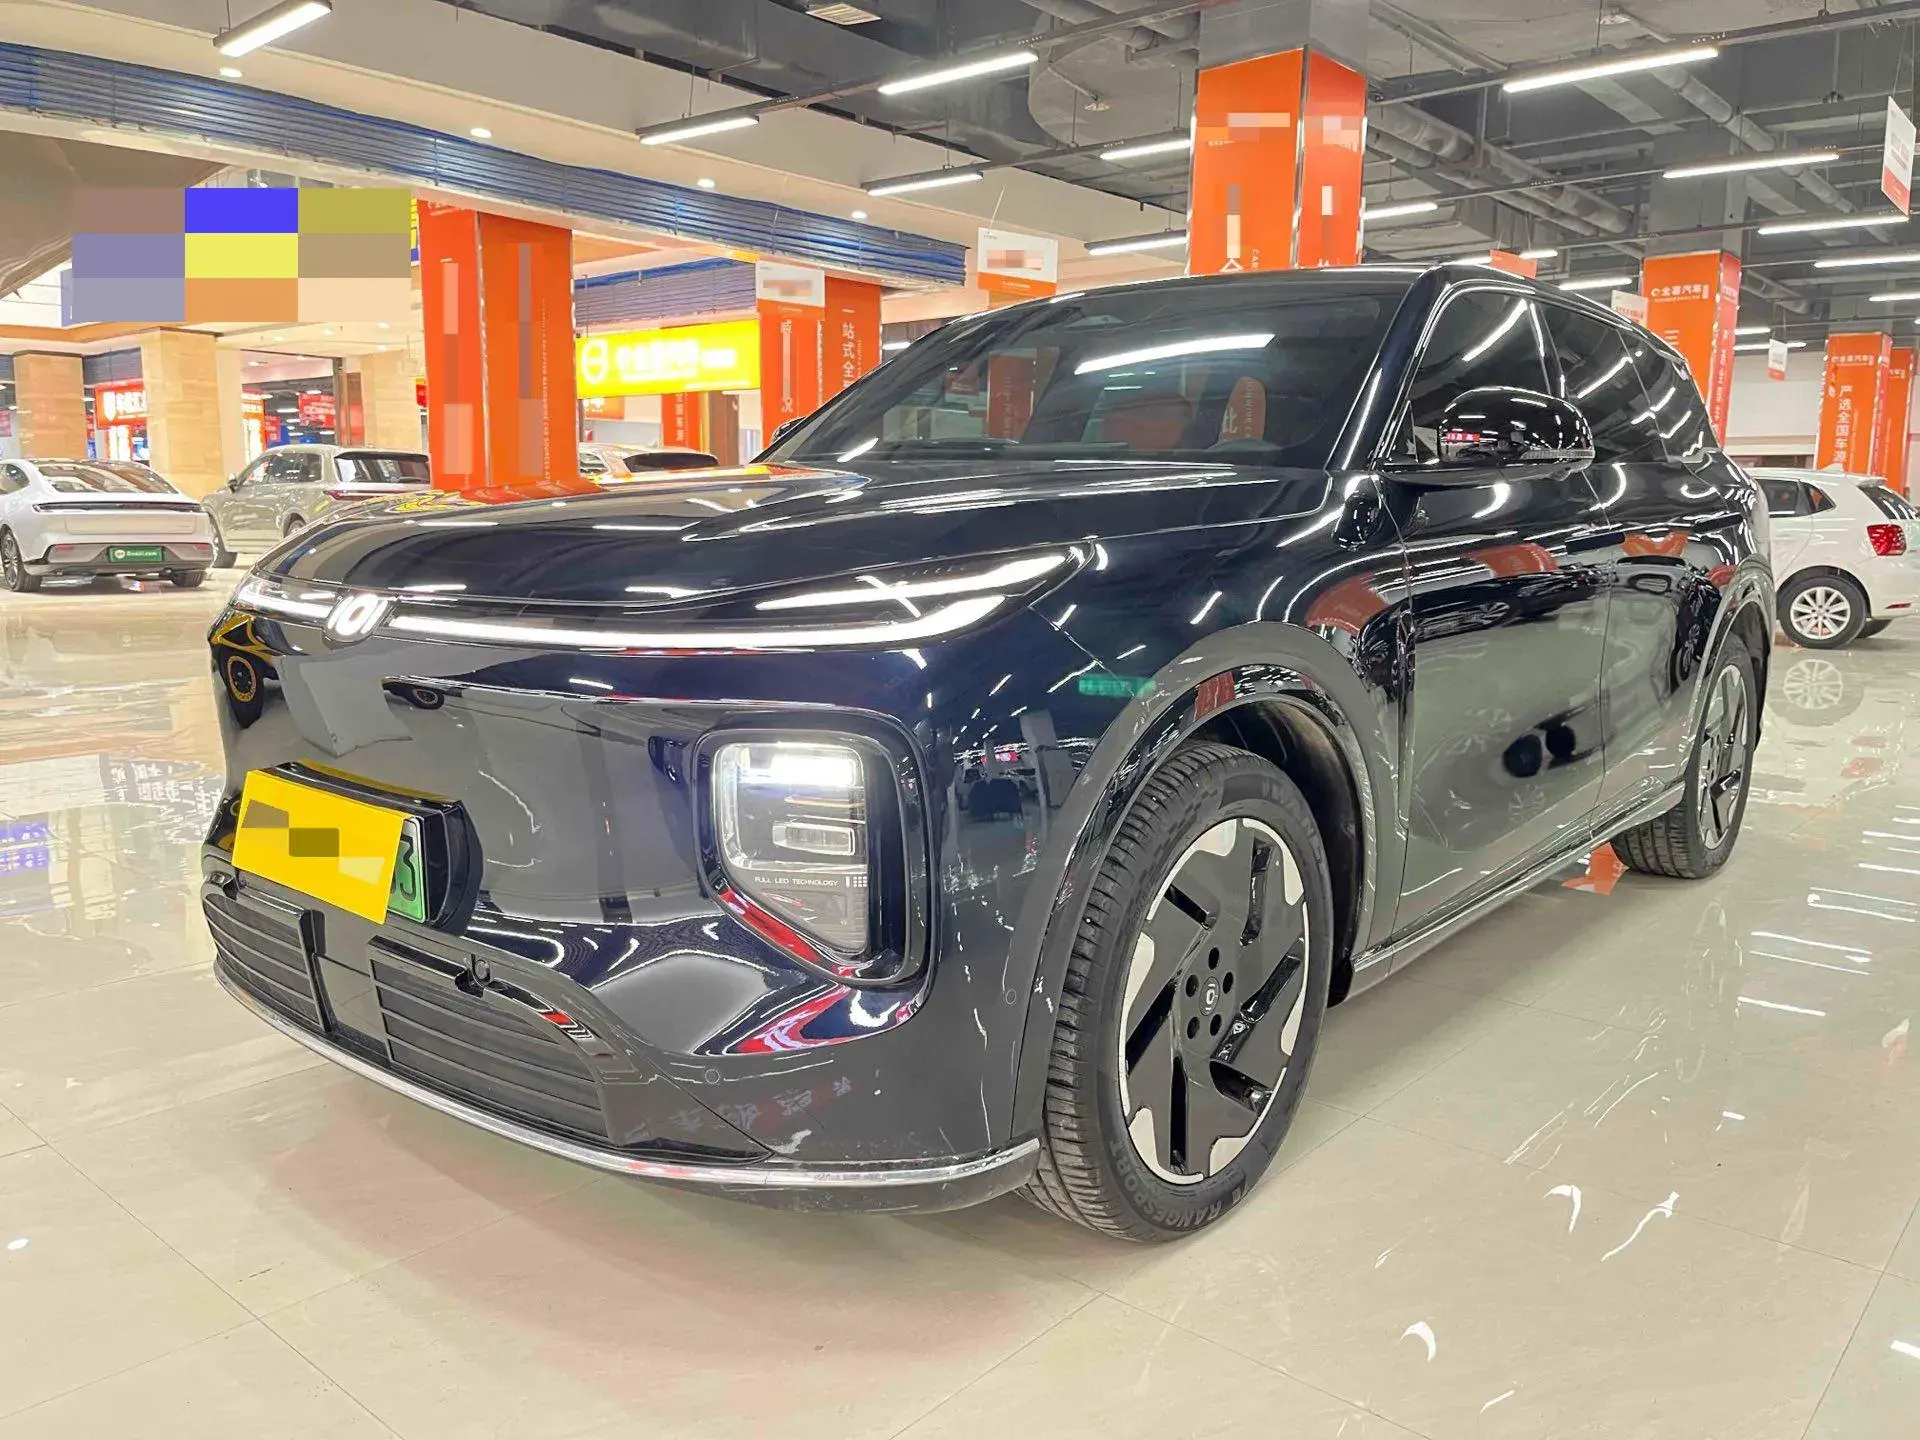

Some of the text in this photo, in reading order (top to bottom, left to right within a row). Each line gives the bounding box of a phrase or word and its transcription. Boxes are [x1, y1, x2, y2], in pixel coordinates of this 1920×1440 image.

[1833, 385, 1853, 462] 严选全国车源
[754, 876, 771, 884] FULL
[792, 878, 839, 886] TECHNOLOGY
